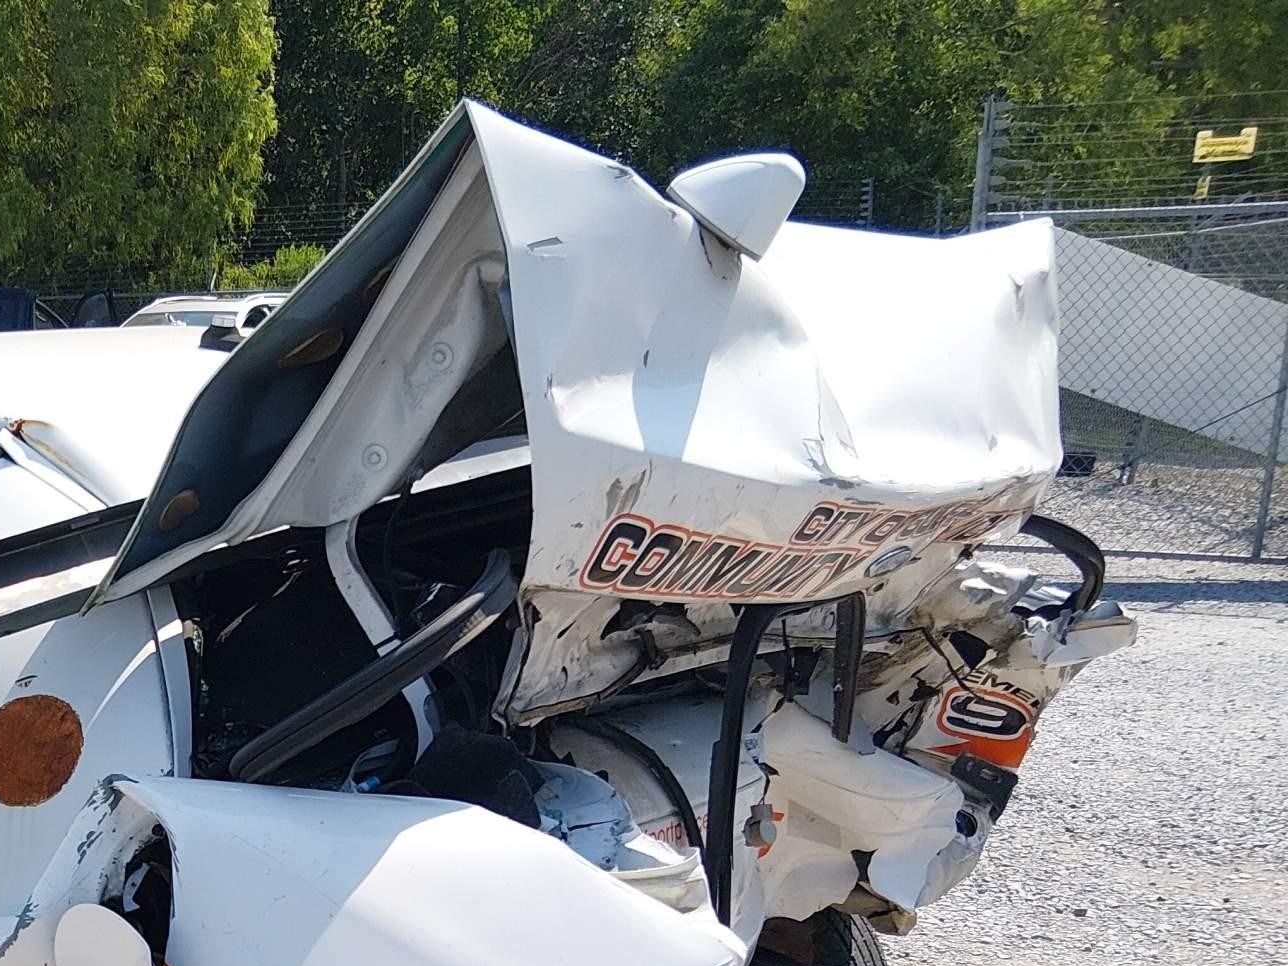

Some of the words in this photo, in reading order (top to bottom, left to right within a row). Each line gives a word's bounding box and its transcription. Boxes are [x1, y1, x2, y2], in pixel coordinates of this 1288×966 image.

[791, 504, 884, 546] CITY
[582, 515, 874, 598] COMMUNITY
[944, 693, 1028, 736] 9
